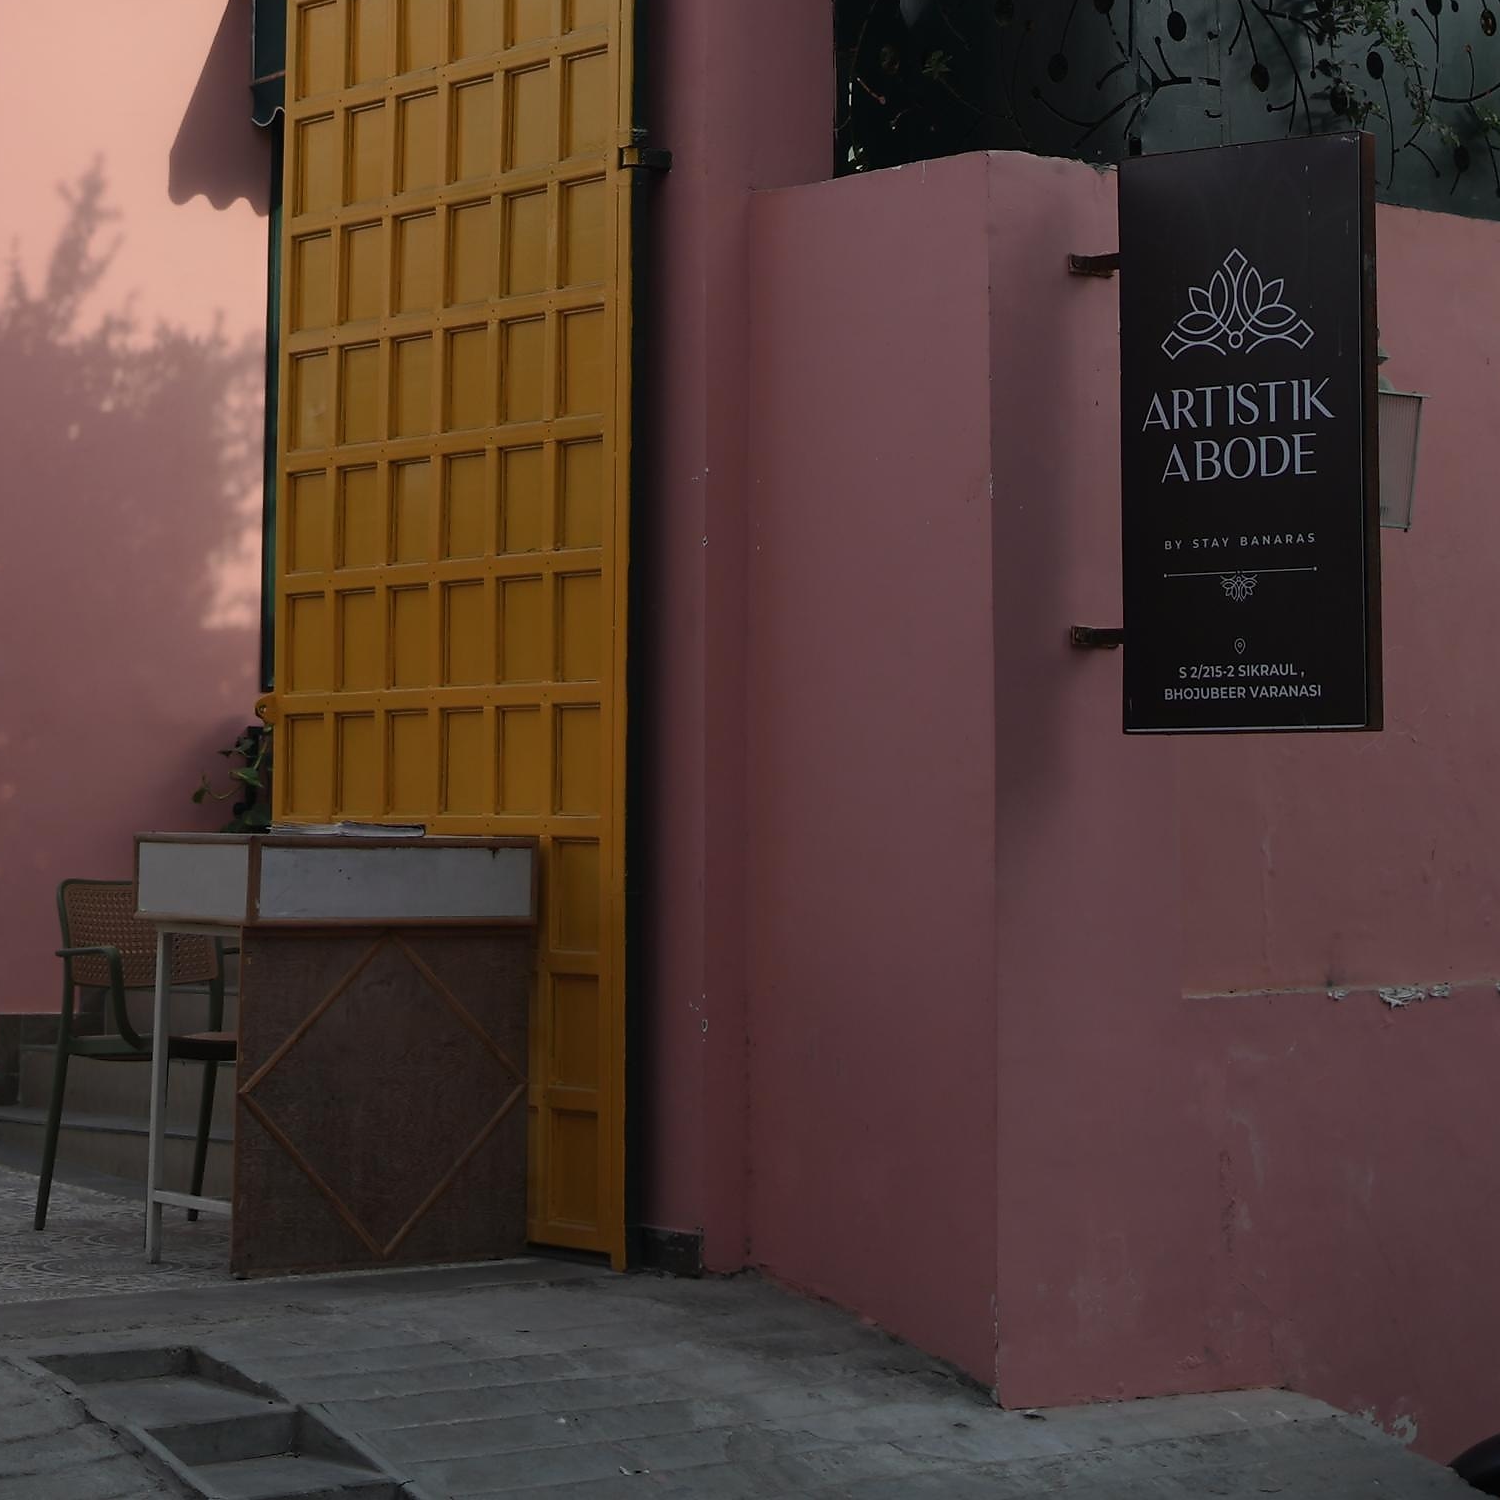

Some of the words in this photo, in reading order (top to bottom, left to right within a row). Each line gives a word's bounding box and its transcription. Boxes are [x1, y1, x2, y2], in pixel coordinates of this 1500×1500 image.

[1142, 377, 1335, 432] ARTISTIK
[1161, 433, 1316, 483] ABODE
[1164, 540, 1182, 550] BY
[1192, 537, 1229, 548] STAY
[1240, 533, 1316, 547] BANARAS
[1179, 667, 1187, 679] S
[1190, 665, 1235, 679] 2/215-2
[1238, 664, 1297, 677] SIKRAUL
[1165, 686, 1246, 700] BHOJUBEER
[1249, 685, 1321, 698] VARANASI
